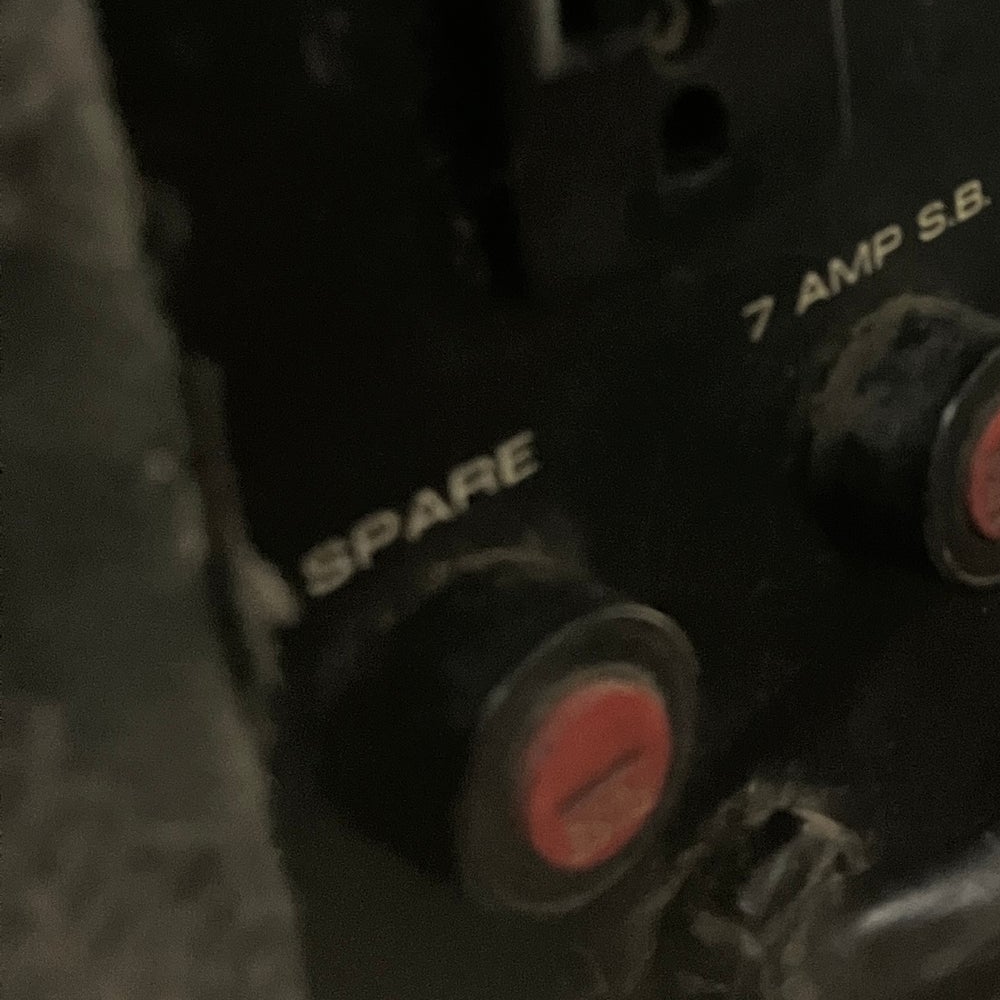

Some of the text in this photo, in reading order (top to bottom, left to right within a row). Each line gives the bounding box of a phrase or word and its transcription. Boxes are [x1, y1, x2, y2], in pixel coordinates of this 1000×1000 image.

[741, 178, 993, 343] 7 AMP S.B.
[299, 430, 541, 597] SPARE
